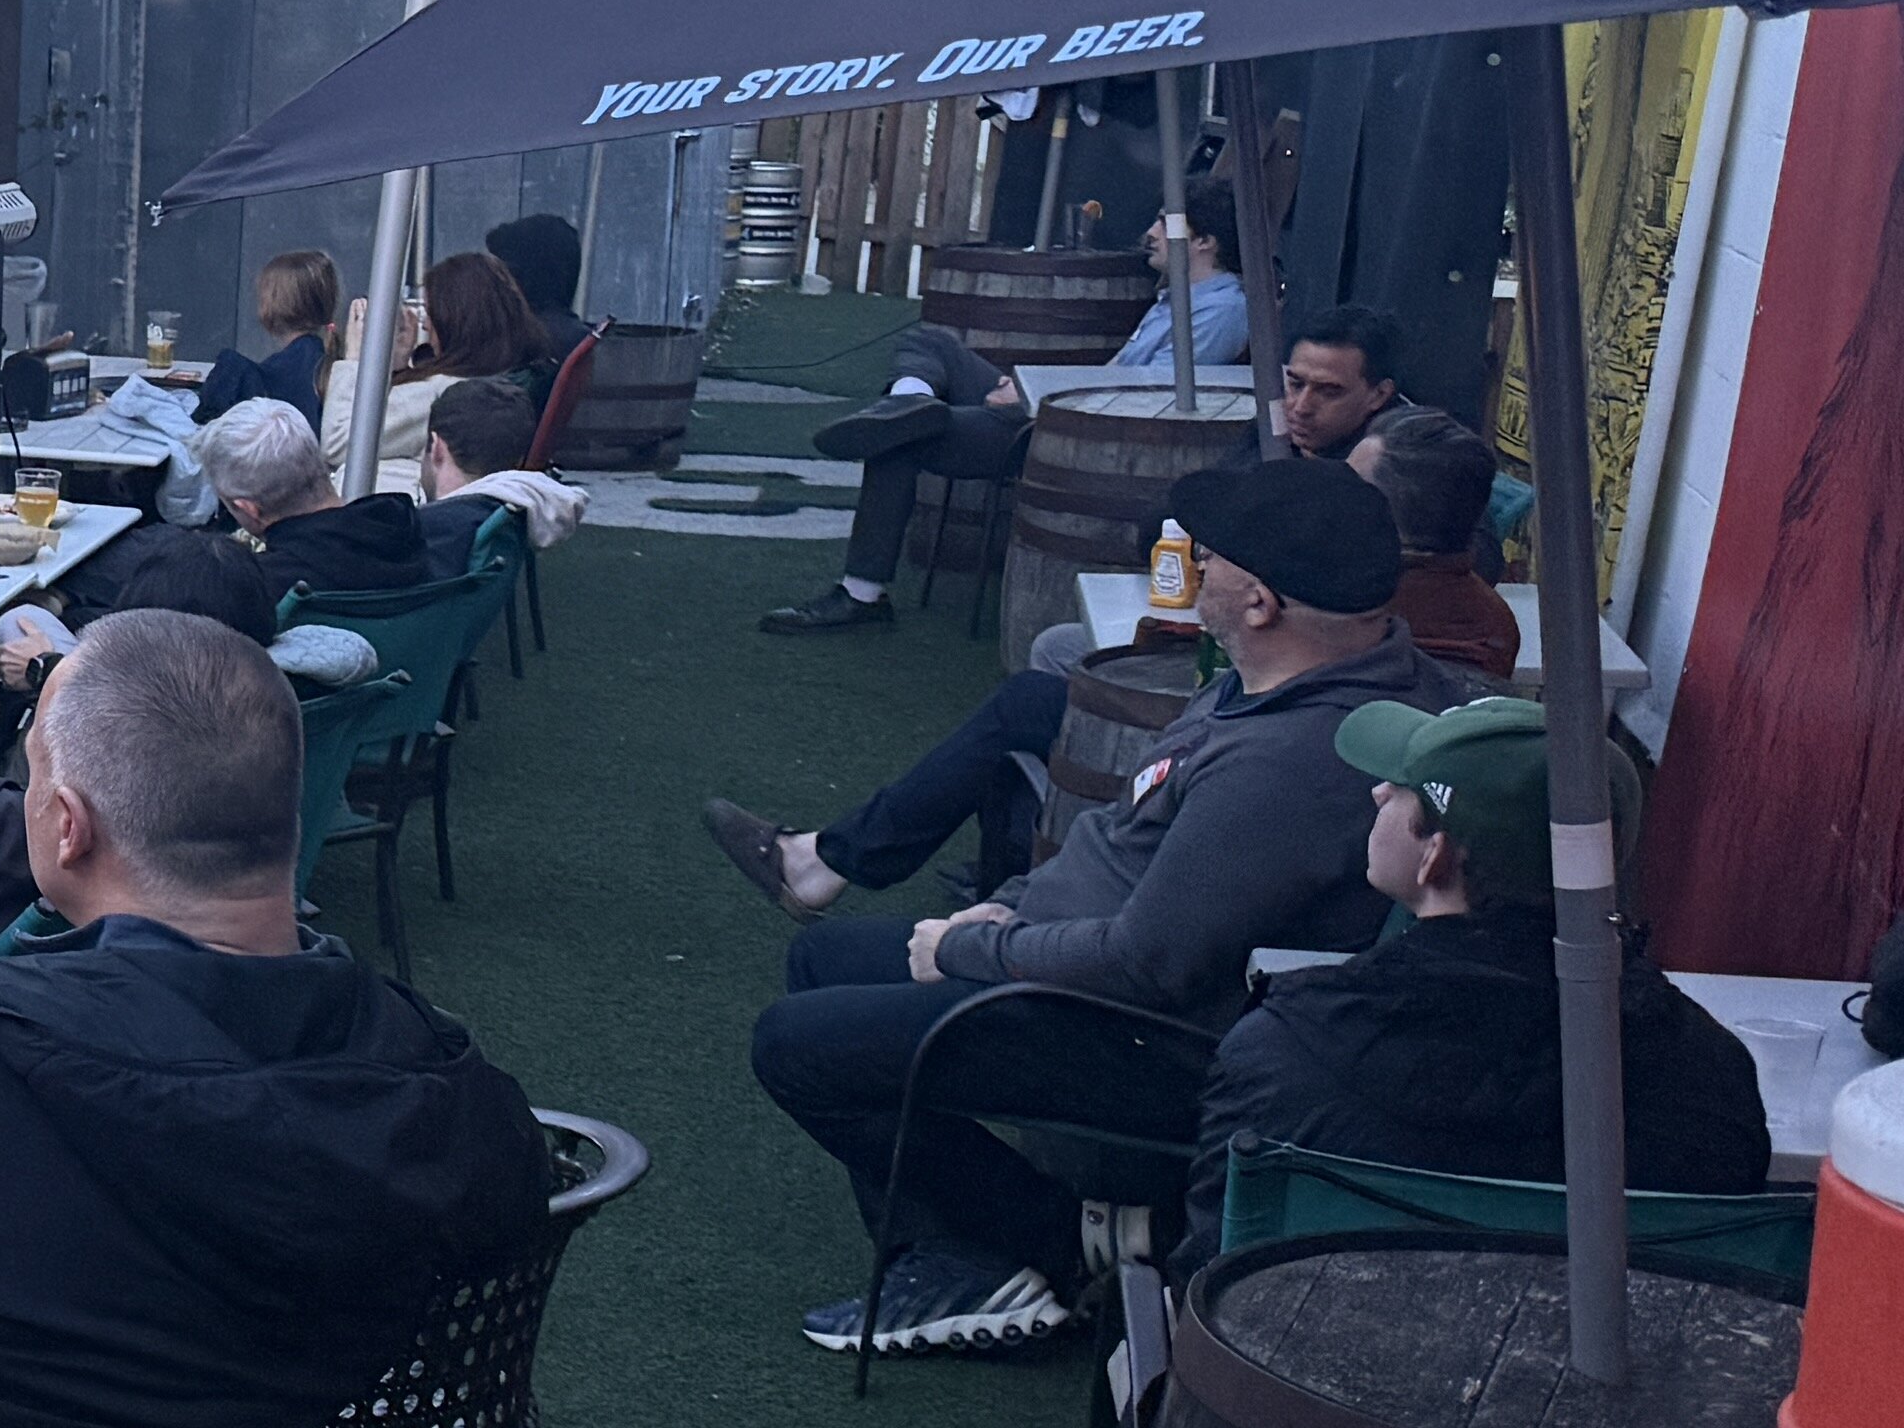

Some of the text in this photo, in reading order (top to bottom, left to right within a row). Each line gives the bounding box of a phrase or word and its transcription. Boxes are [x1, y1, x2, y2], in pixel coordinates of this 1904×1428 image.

[581, 10, 1206, 125] YOUR STORY. OUR BEER.
